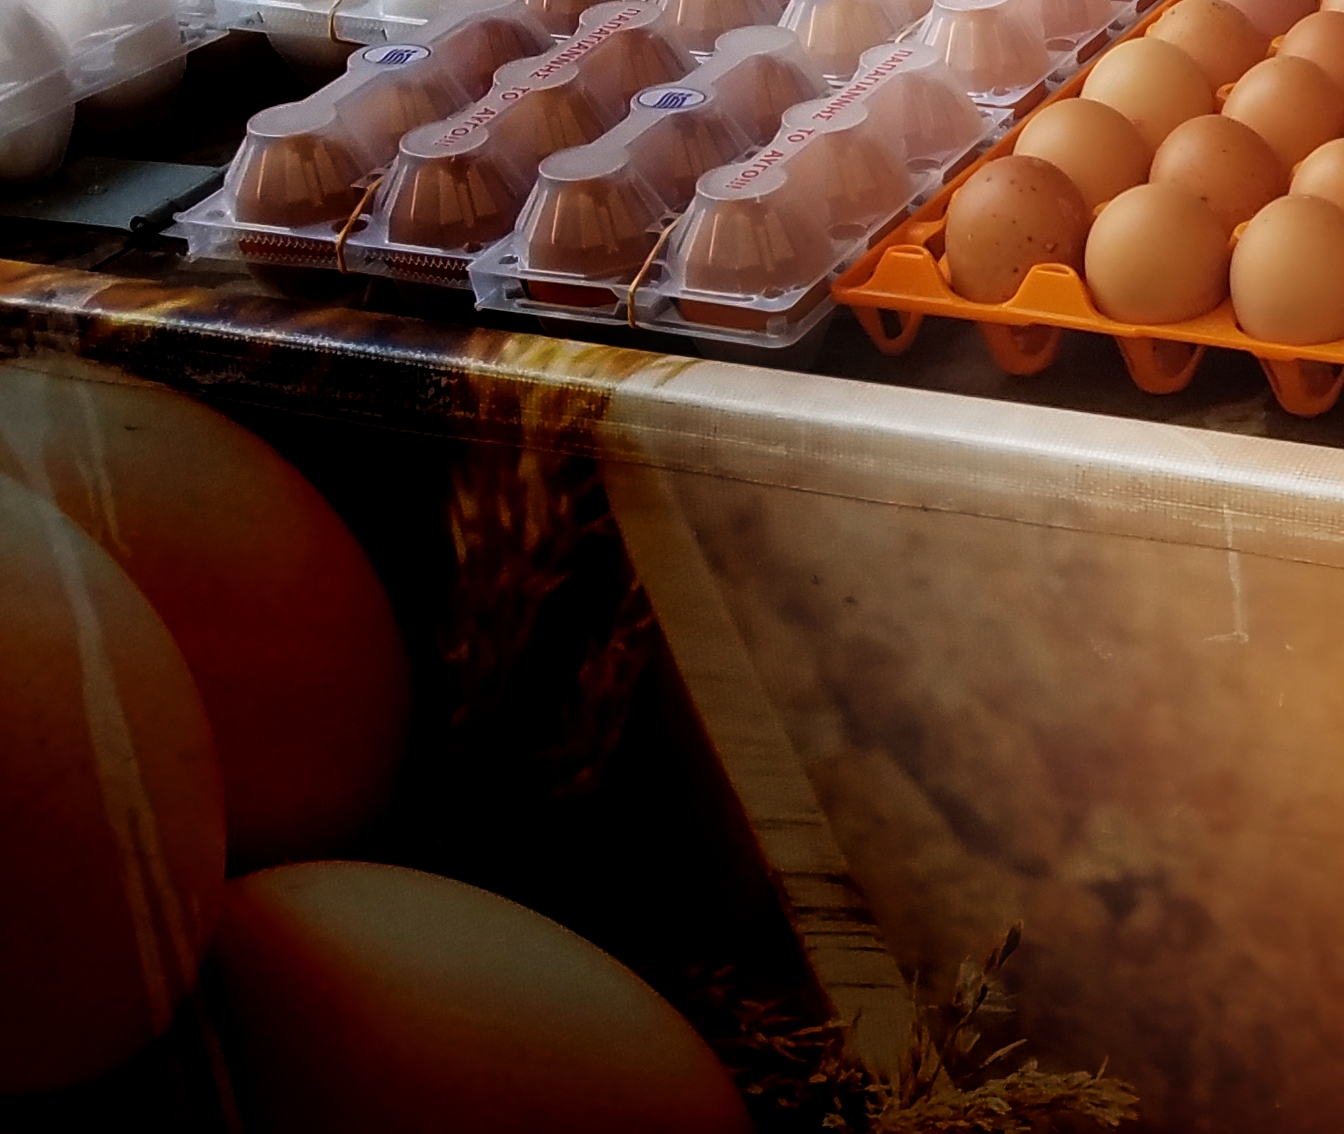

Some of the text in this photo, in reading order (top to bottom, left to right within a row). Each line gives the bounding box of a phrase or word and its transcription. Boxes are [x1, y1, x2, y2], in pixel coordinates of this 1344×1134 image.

[529, 7, 642, 80] ΠΑΠΑΓΙΑΝΝΗΣ
[501, 86, 532, 101] ΤΟ
[725, 49, 913, 190] ΠΑΠΑΓΙΑΝΝΗΣ ΤΟ ΑΥΓΟ!!!
